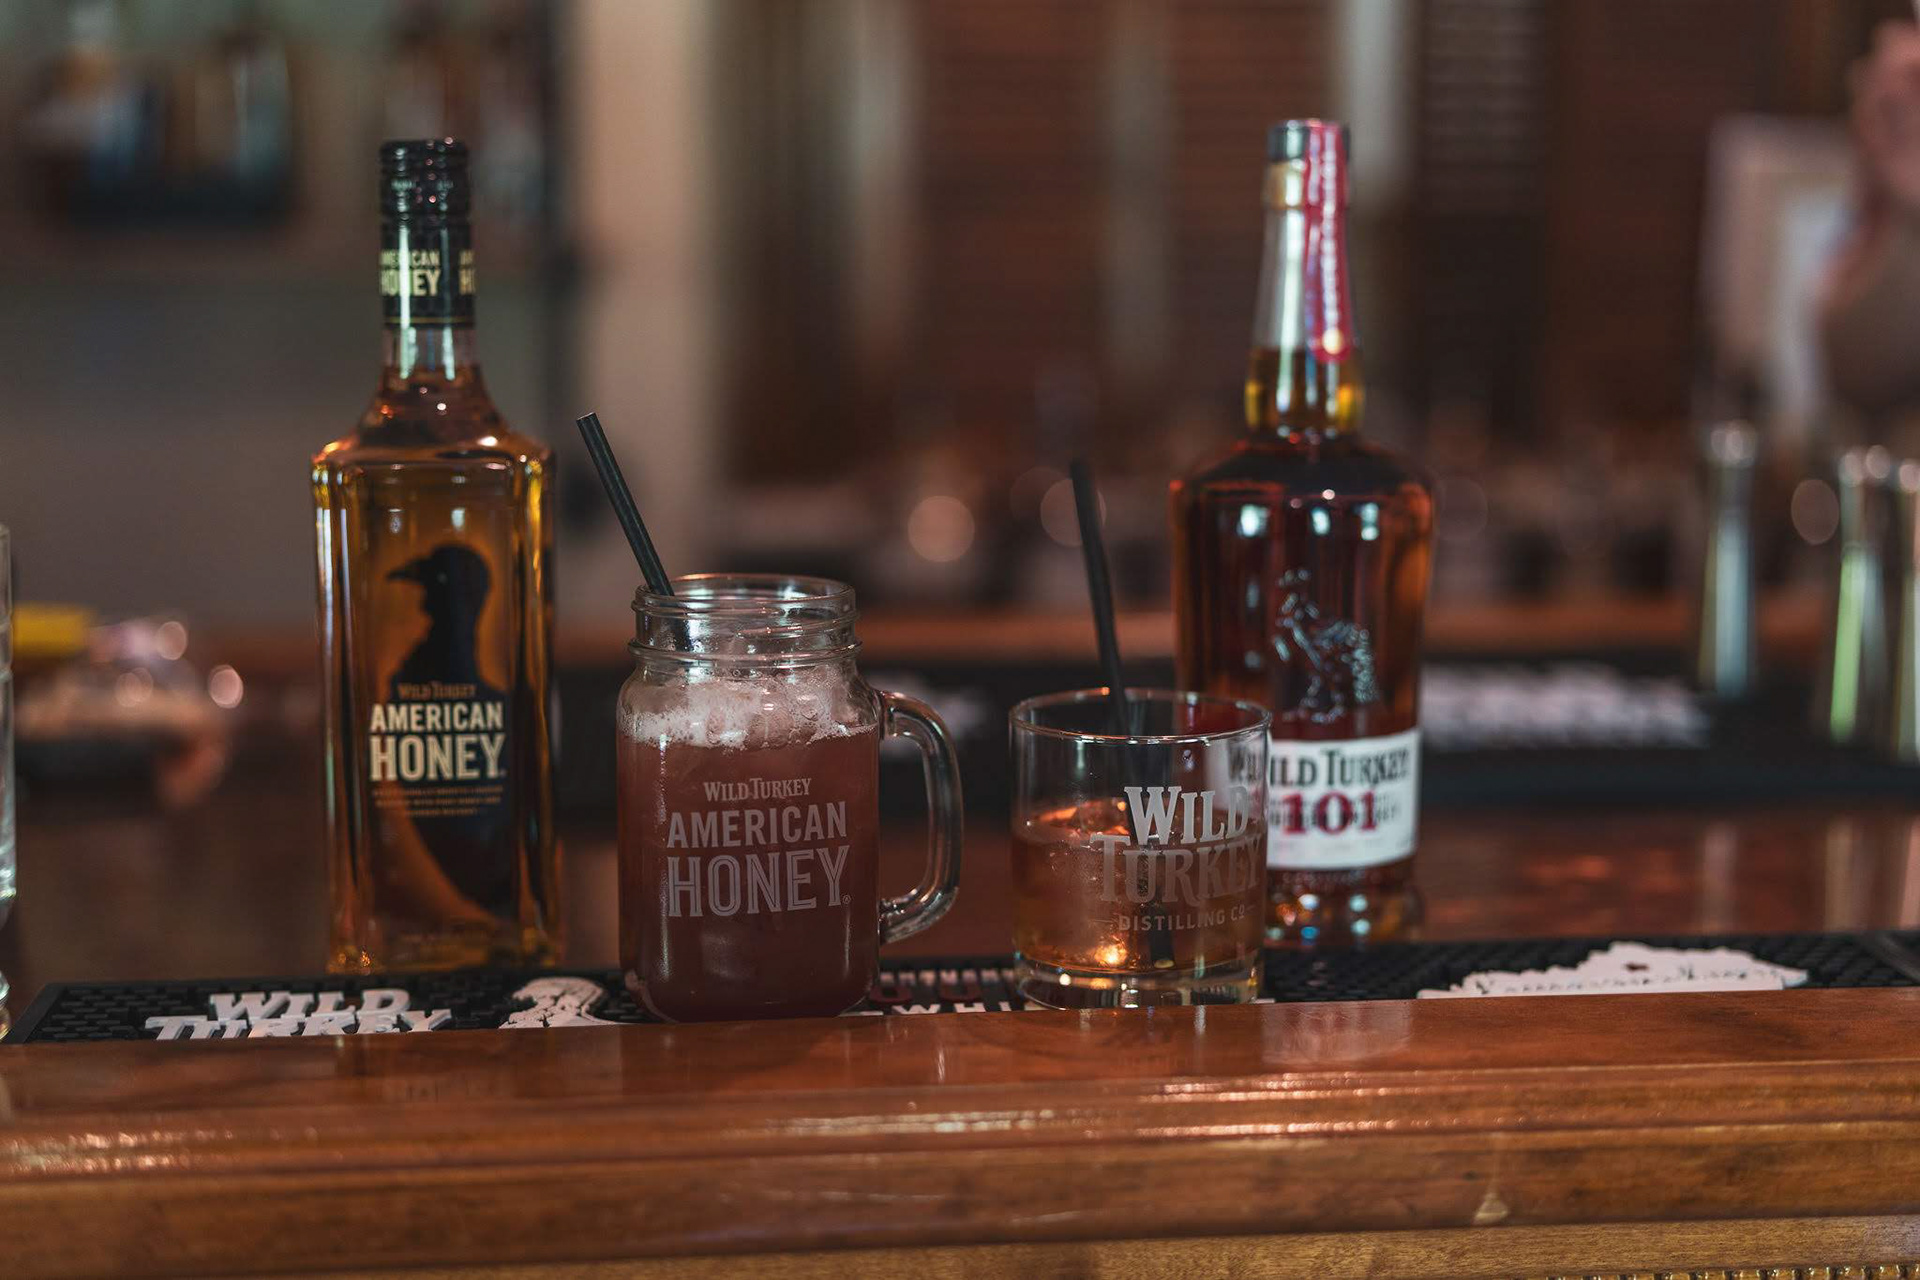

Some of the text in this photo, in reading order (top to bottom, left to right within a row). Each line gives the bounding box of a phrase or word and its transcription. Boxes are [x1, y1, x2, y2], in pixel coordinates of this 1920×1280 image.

[381, 269, 441, 296] HOEY
[370, 702, 503, 732] AMERICAN
[370, 733, 505, 781] HONEY
[1320, 748, 1409, 787] TURKEY
[703, 777, 812, 801] WILD TURKEY
[1282, 788, 1378, 835] 101
[667, 801, 847, 848] AMERICAN
[1124, 786, 1250, 846] WILD
[667, 845, 850, 917] HONEY
[1090, 832, 1261, 908] TURKEY
[210, 988, 411, 1021] WILD
